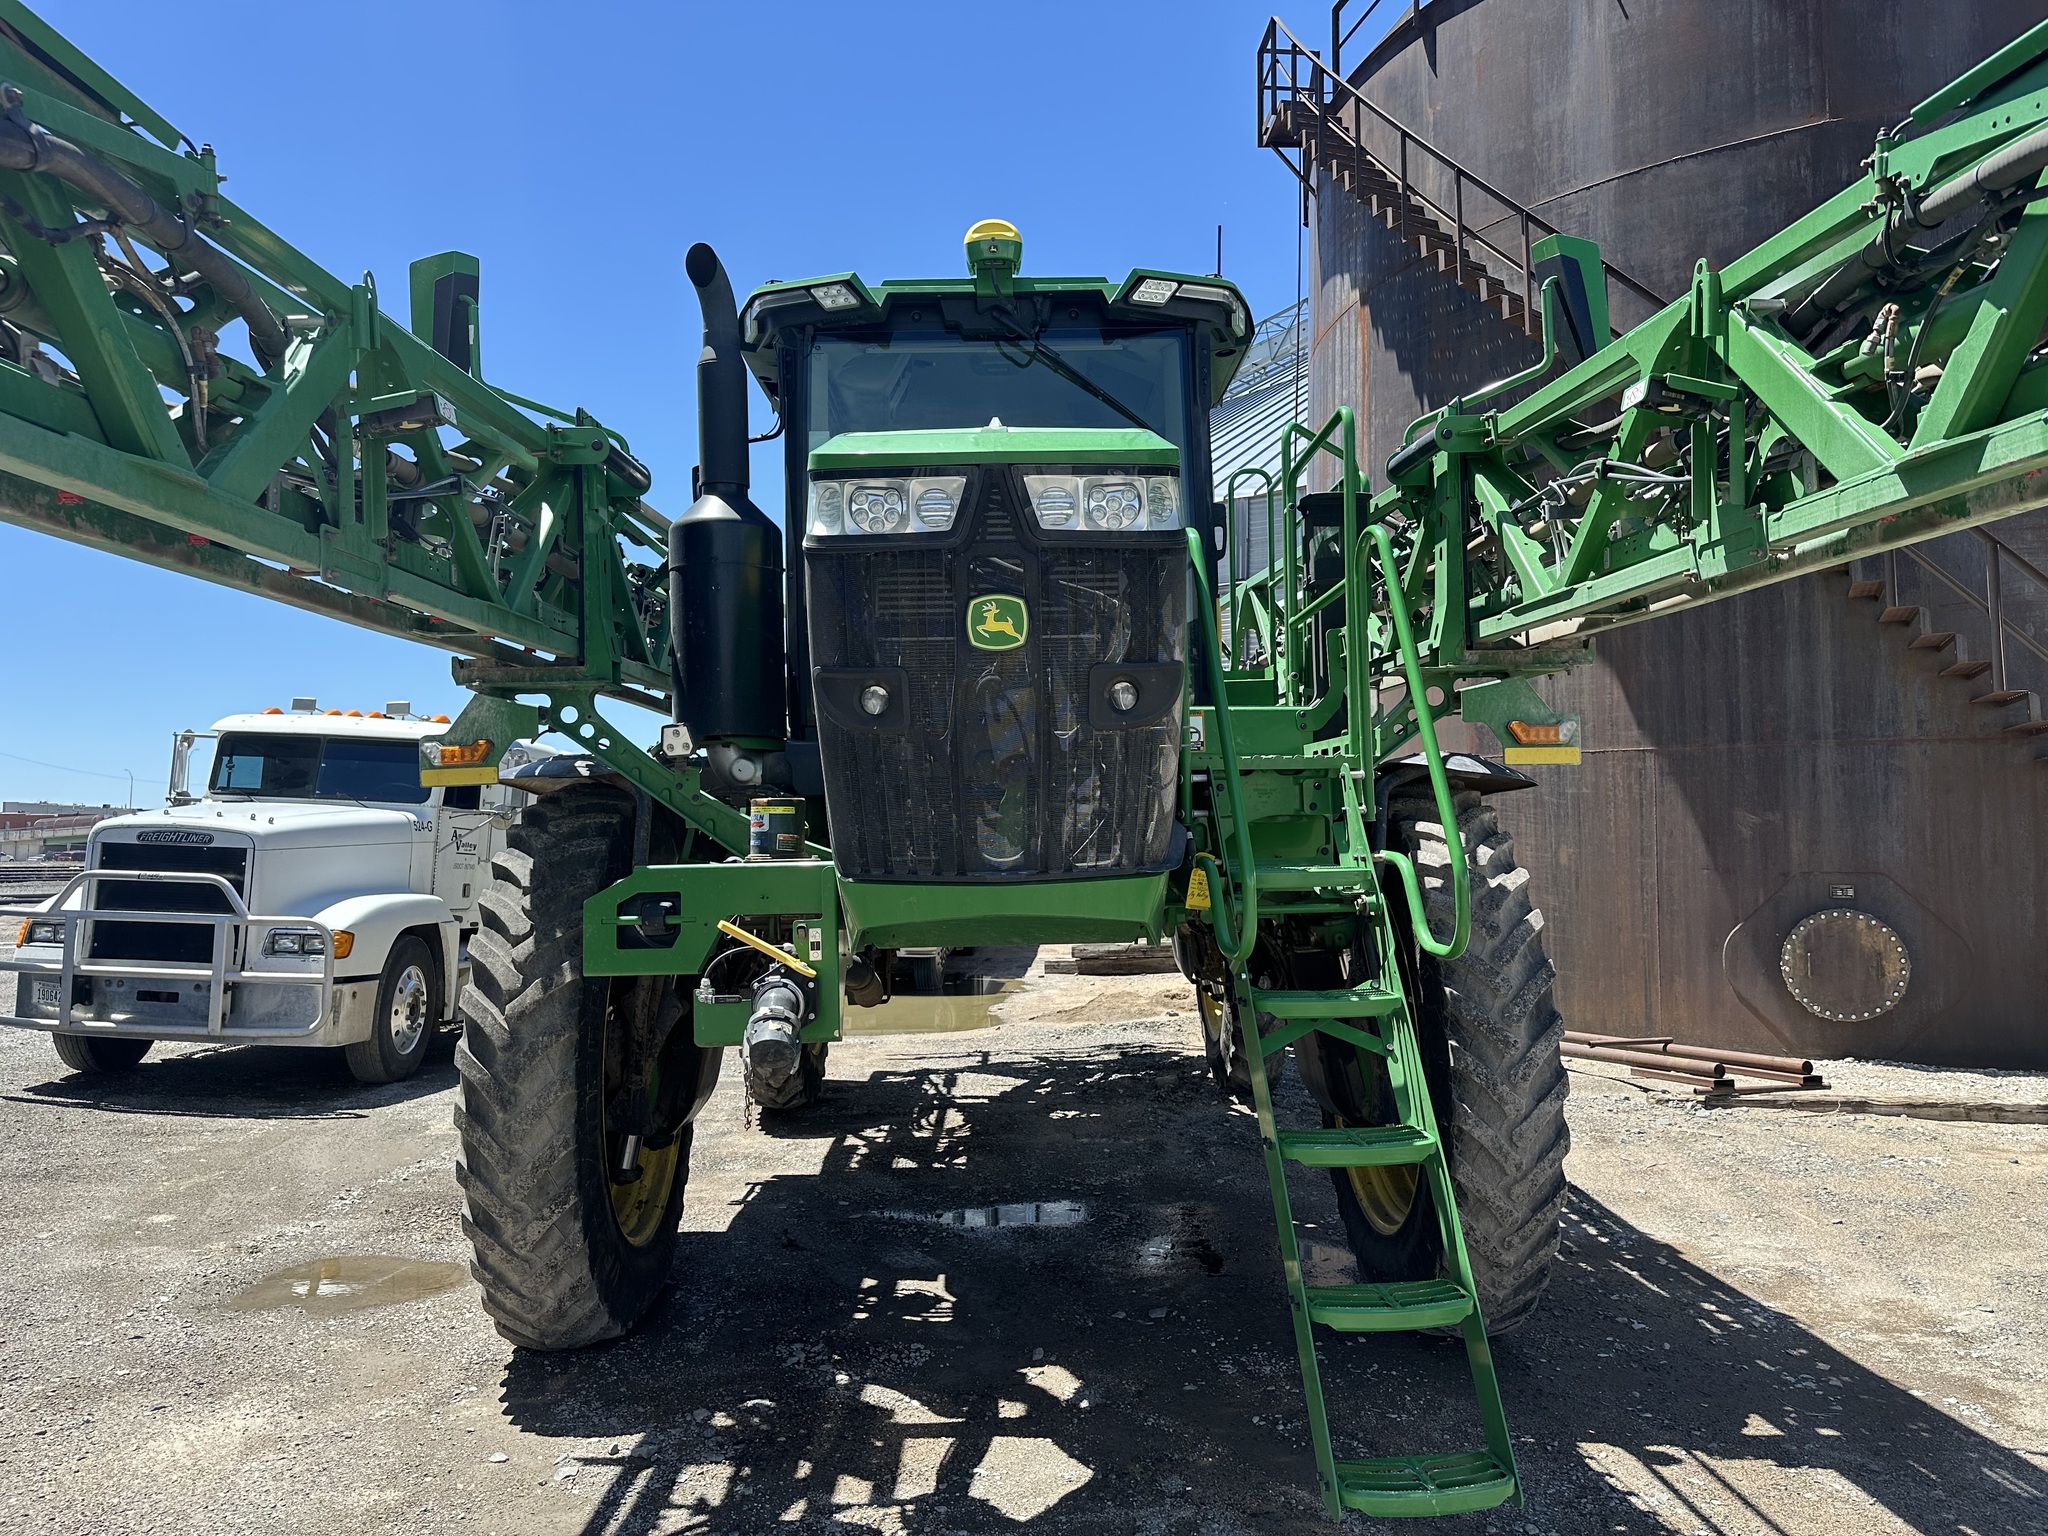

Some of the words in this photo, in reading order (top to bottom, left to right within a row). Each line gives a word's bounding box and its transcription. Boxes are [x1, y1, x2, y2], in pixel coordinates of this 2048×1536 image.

[413, 820, 433, 832] 524-G
[140, 831, 211, 843] FREIGHTLINER
[456, 840, 477, 851] Valley
